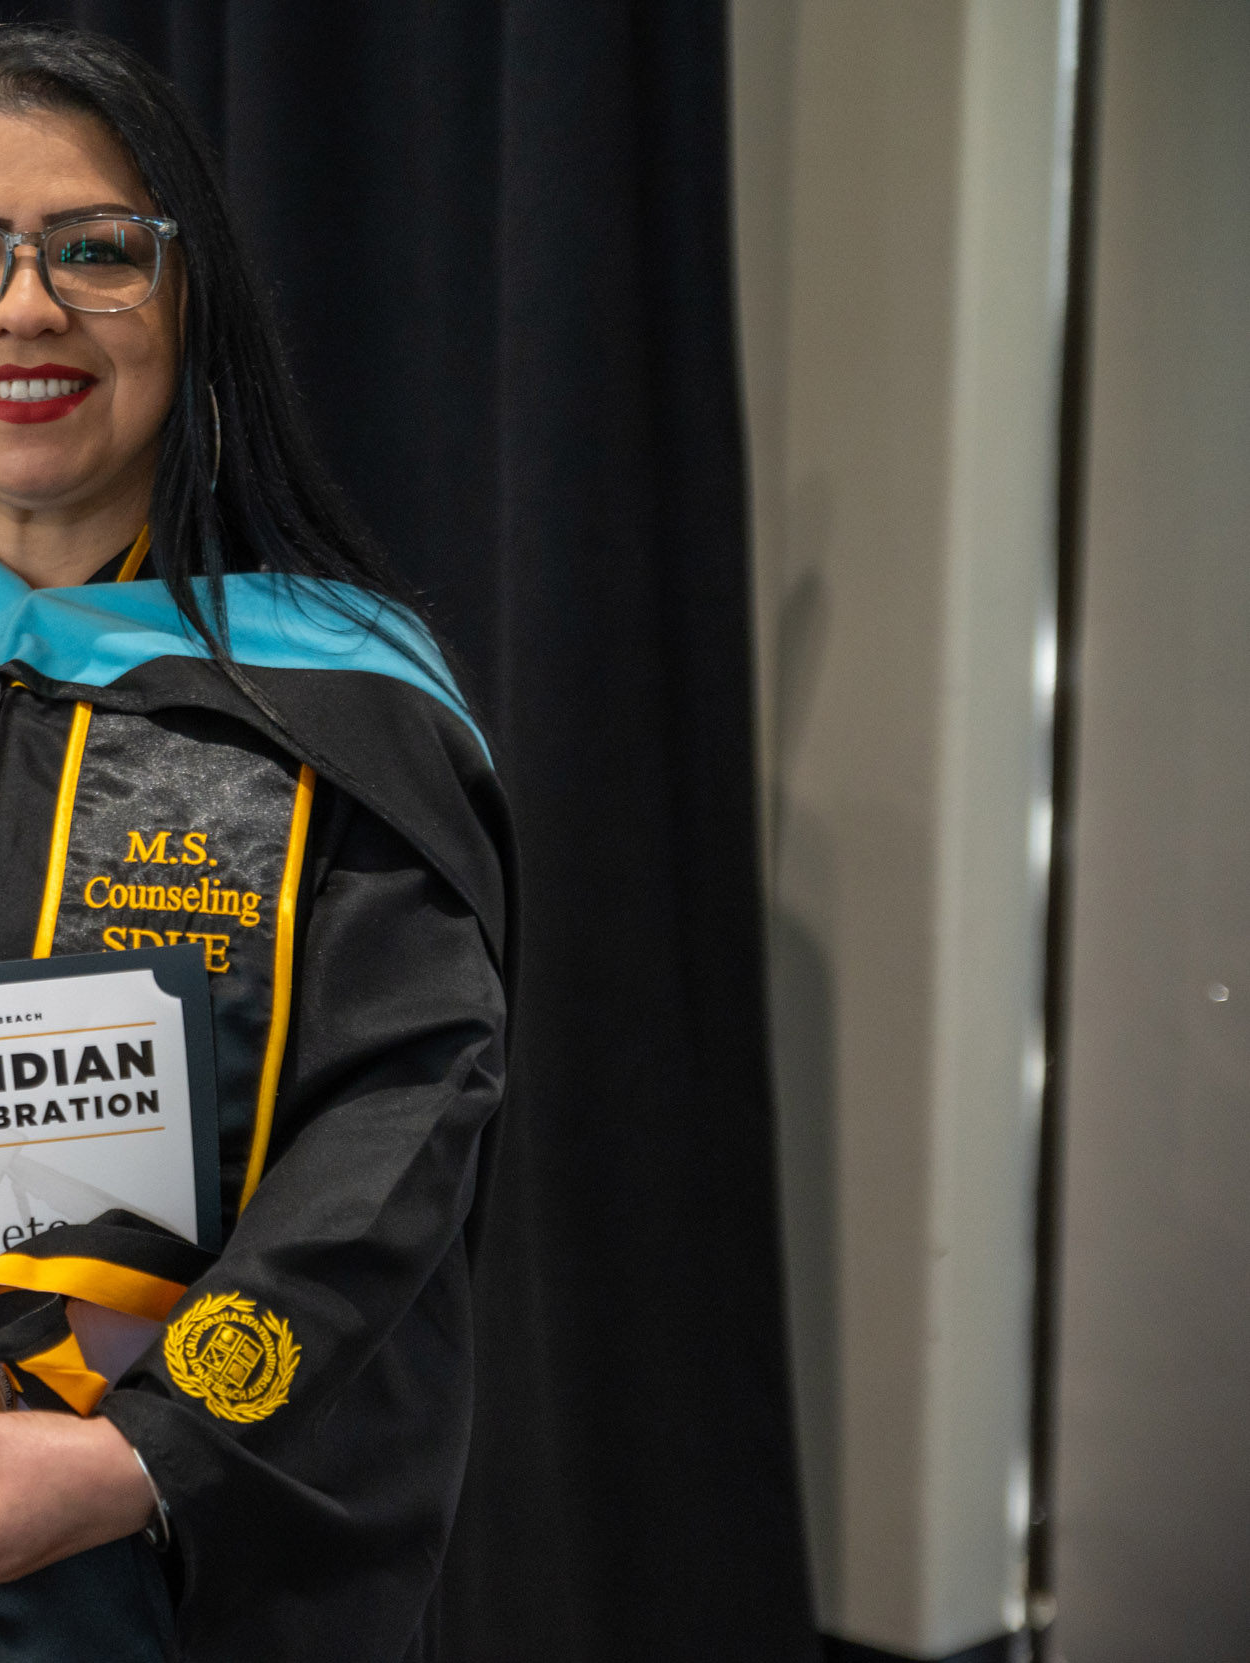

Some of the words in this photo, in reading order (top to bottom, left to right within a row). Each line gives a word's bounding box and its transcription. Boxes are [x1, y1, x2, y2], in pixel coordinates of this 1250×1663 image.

[124, 831, 217, 867] M.S.
[84, 876, 262, 927] Counseling
[185, 1312, 240, 1358] CALIFORNIA
